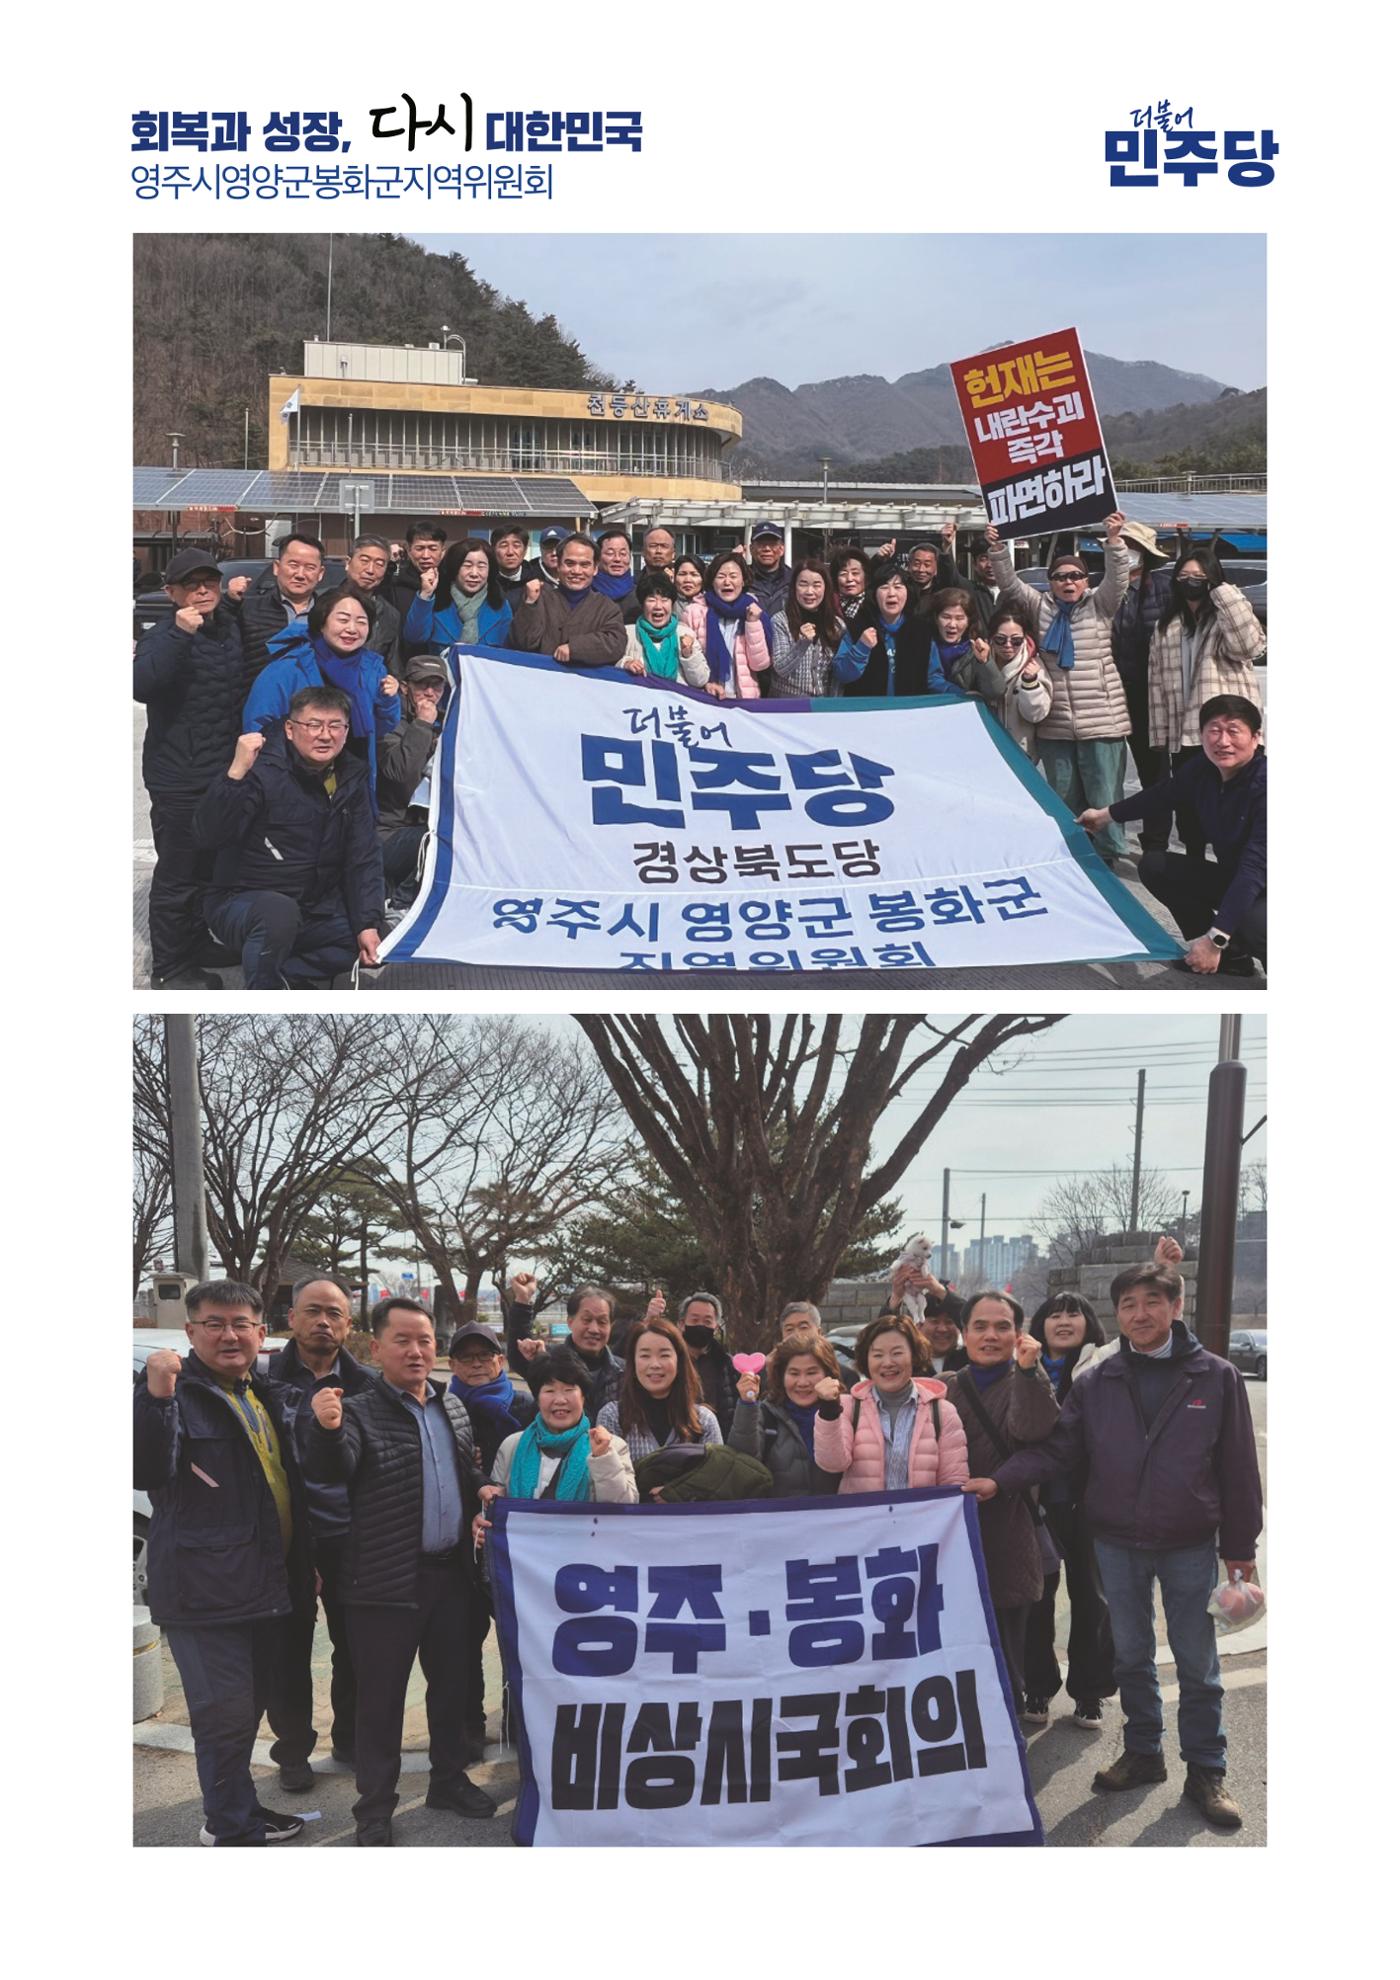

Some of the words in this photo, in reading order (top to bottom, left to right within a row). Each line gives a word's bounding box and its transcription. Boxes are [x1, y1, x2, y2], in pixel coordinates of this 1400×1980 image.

[964, 351, 1076, 408] 헌재는
[587, 394, 709, 421] 천등산휴게소
[974, 391, 1085, 443] 내란수괴
[1007, 430, 1065, 465] 즉각
[988, 455, 1106, 526] 파면하라
[622, 705, 732, 748] 더불어
[581, 733, 895, 830] 민주당
[633, 839, 881, 884] 경상북도당
[492, 897, 660, 943] 영주시
[681, 896, 854, 943] 영양군
[869, 876, 1049, 933] 봉화군
[551, 1669, 987, 1811] 비상시국회의
